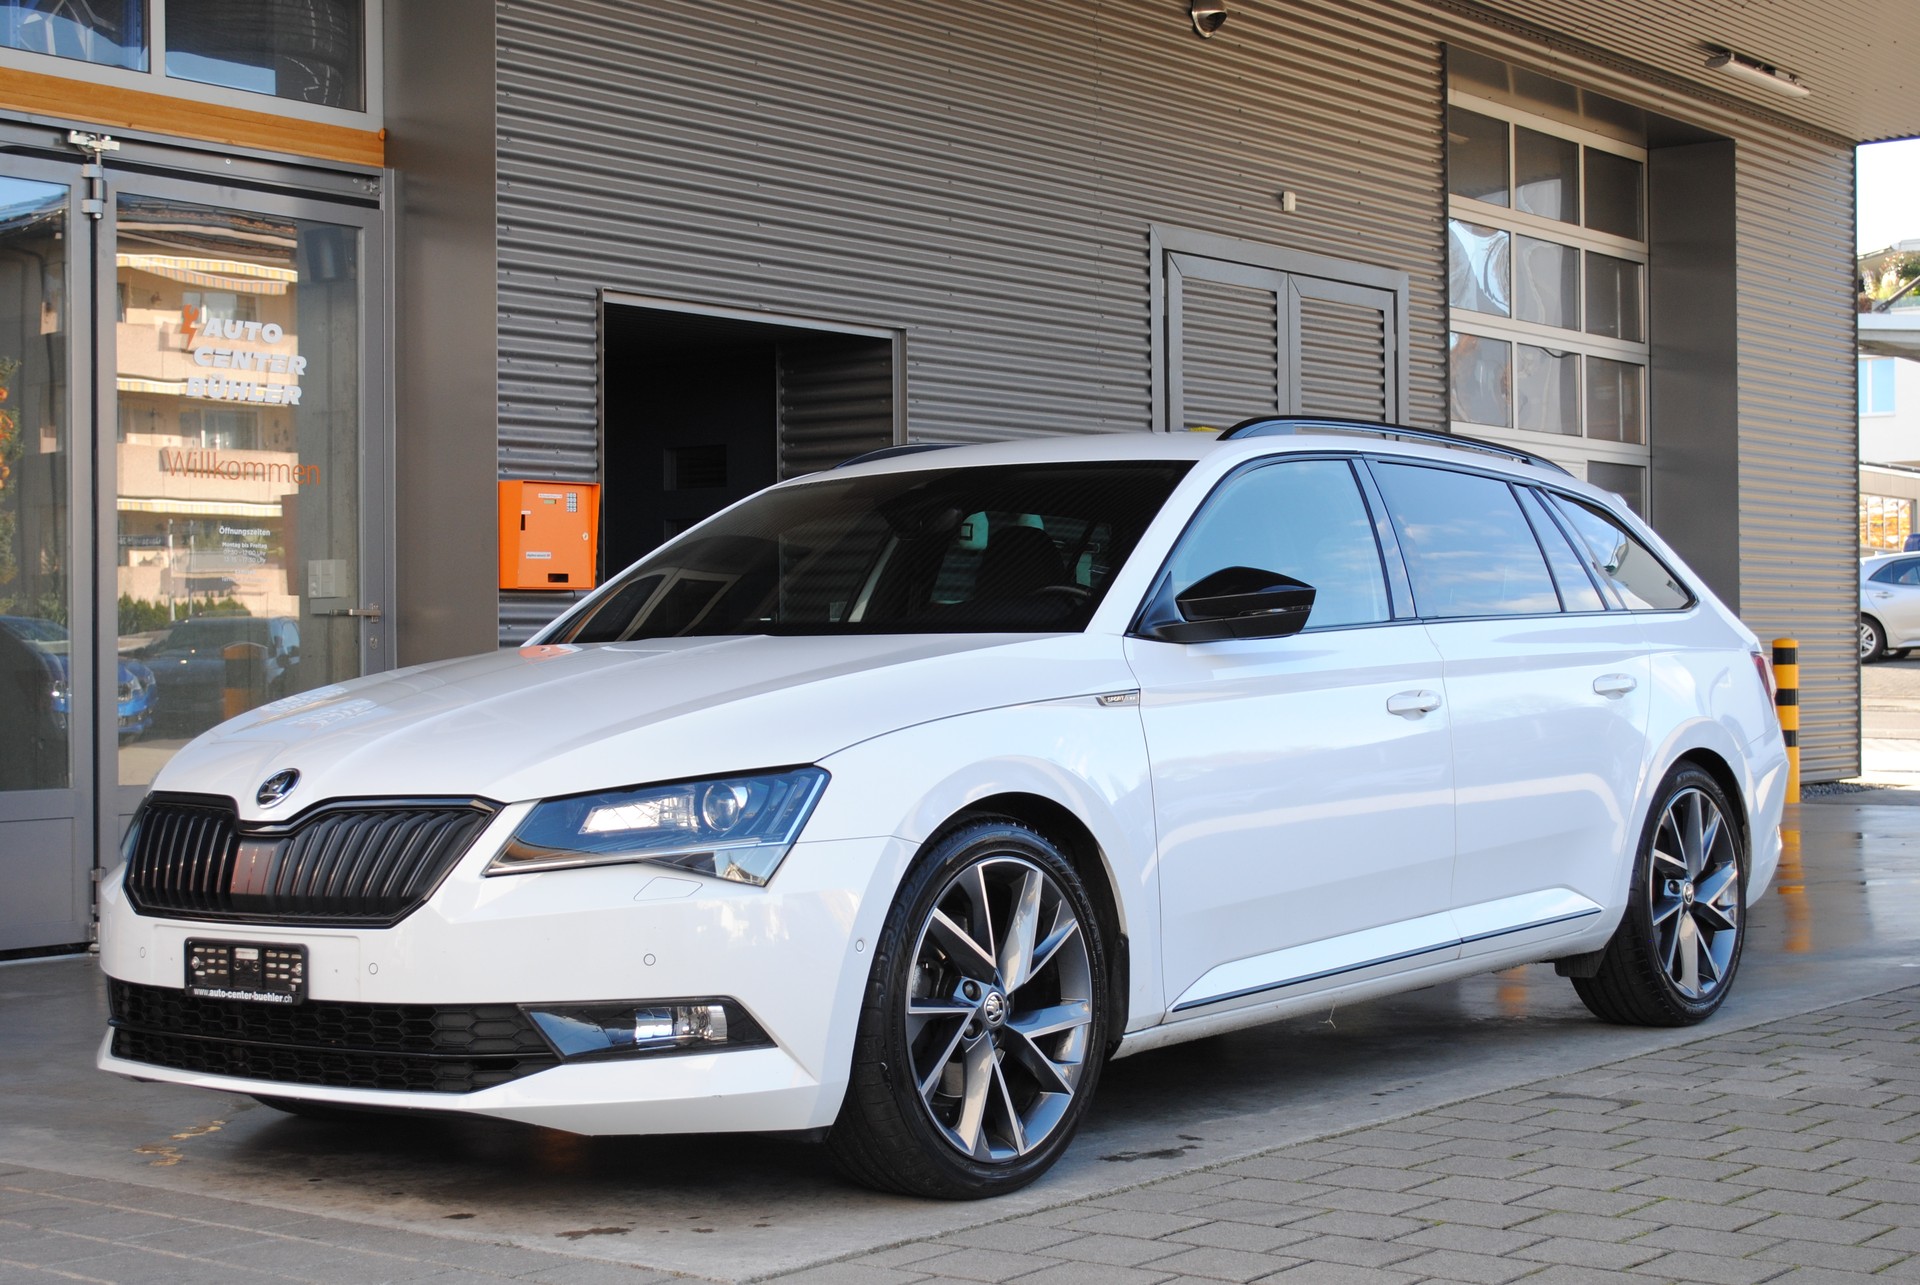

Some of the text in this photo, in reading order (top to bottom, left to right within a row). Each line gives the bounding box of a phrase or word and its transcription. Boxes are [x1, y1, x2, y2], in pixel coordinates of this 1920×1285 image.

[203, 317, 283, 344] AUTO
[193, 345, 307, 375] CENTER
[186, 373, 302, 405] BÜHLER
[166, 450, 320, 486] Willkommen
[219, 525, 271, 537] Öffnungszeiten
[193, 988, 293, 1003] www.auto-center-buehler.ch
